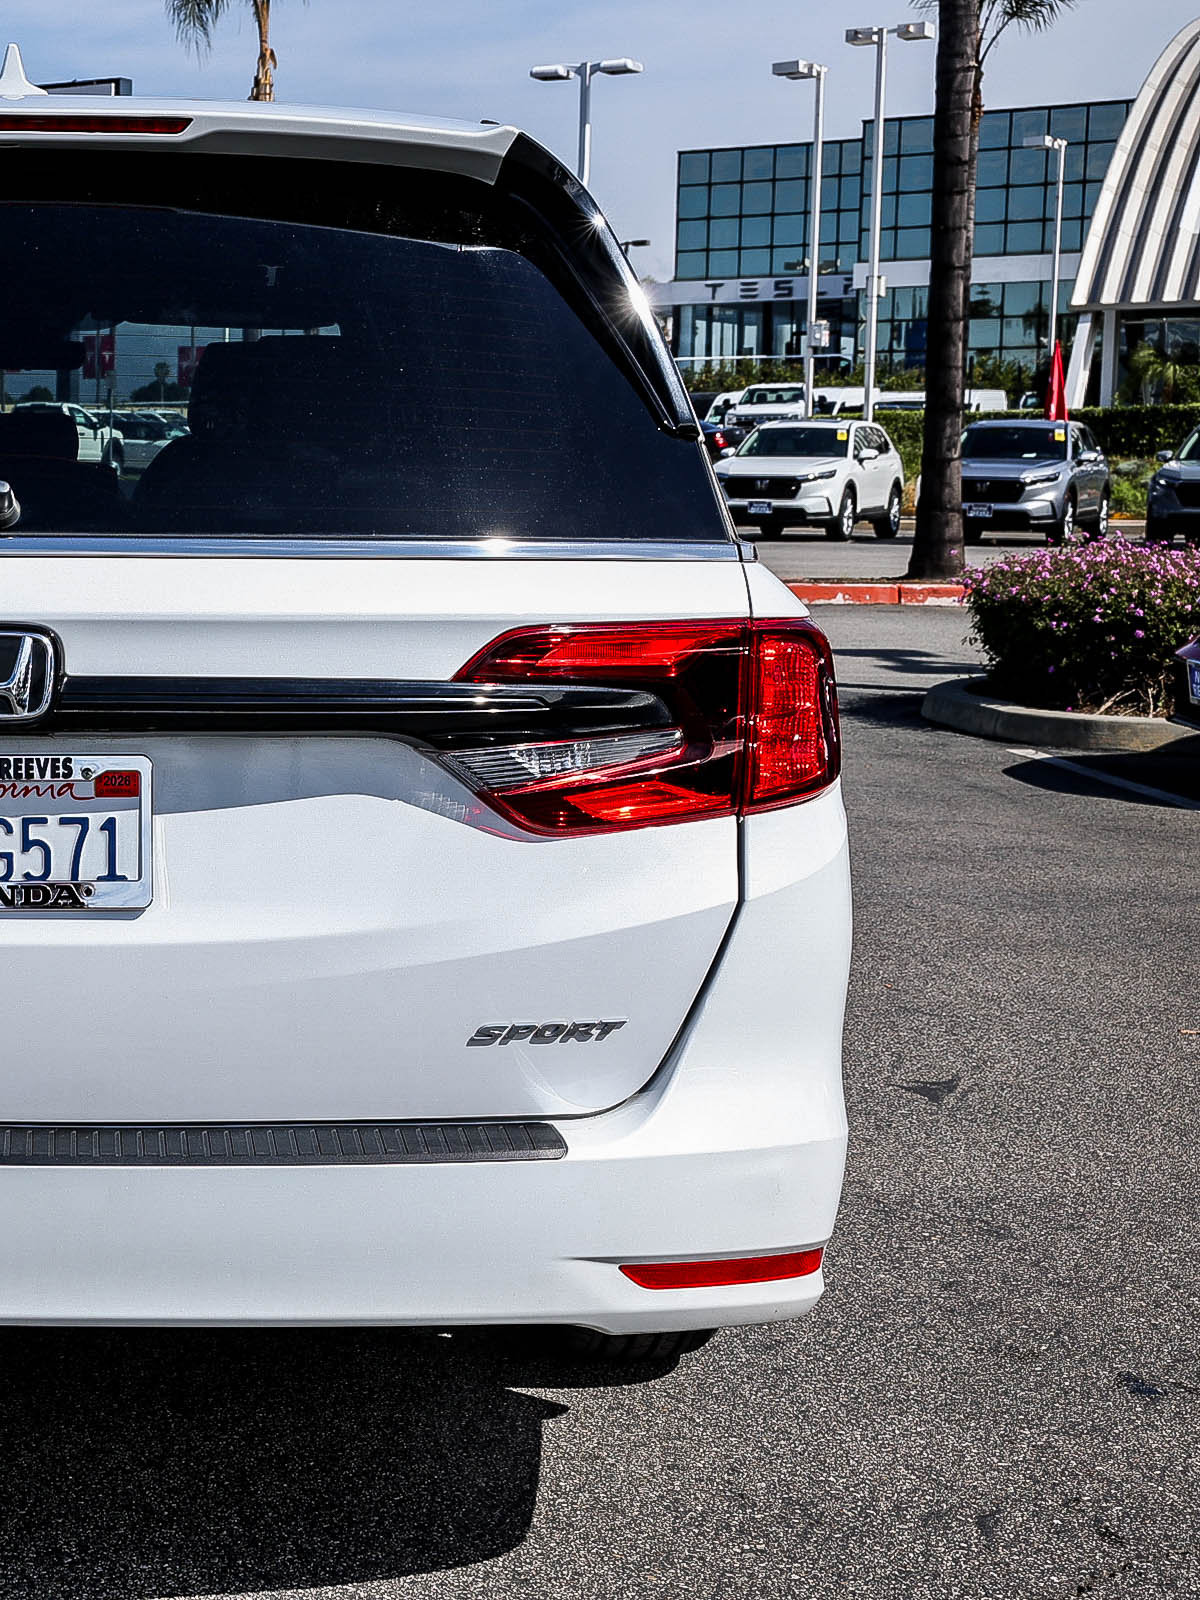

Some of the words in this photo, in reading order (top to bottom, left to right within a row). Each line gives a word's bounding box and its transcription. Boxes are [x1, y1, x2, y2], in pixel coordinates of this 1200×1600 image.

[0, 757, 73, 779] REEVES
[103, 775, 131, 786] 2026
[467, 1019, 629, 1047] SPORT
